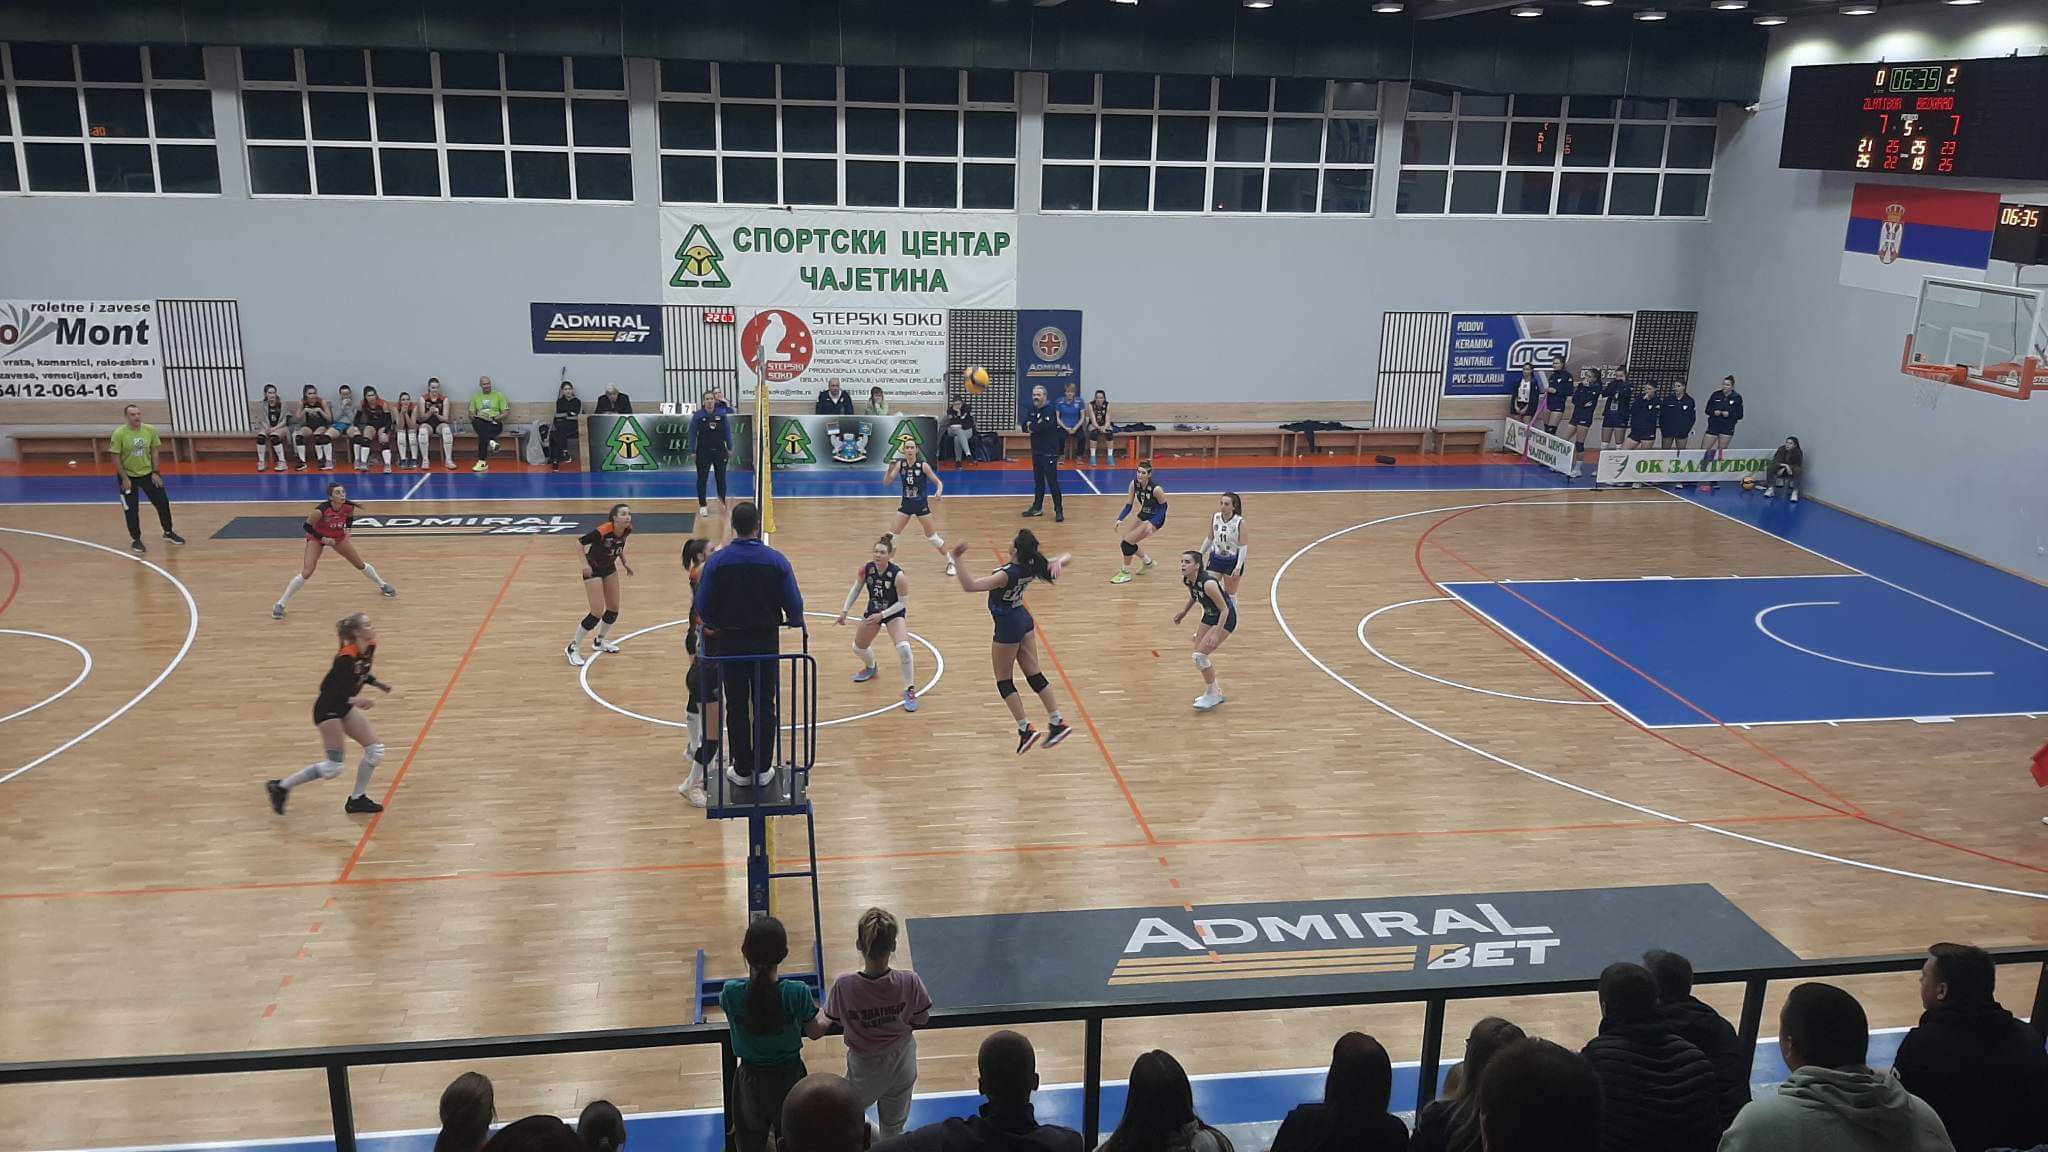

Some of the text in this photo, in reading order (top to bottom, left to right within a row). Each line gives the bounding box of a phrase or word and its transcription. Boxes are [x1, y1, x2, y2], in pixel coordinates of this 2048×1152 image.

[1875, 68, 1958, 90] 0 06:35 2
[1879, 114, 1961, 137] 7 5 7
[1858, 139, 1873, 152] 21
[1910, 139, 1927, 155] 25
[2000, 208, 2040, 228] 06:35
[732, 226, 1011, 259] СПОРТСКИ ЦЕНТАР
[799, 266, 949, 293] ЧАЈЕТИНА
[30, 302, 151, 314] roletne i zavese
[550, 313, 650, 330] ADMIRAL
[812, 311, 942, 327] STEPSKI SOKO
[1457, 321, 1484, 332] PODOVI
[54, 317, 150, 346] Mont
[614, 331, 650, 342] BET
[1455, 338, 1493, 349] KERAMIKA
[767, 362, 804, 371] STEPSKI
[767, 371, 793, 380] SOKO
[1452, 374, 1466, 384] PVC
[351, 515, 580, 527] ADMIRAL
[489, 525, 577, 534] BET
[1122, 903, 1554, 954] ADMIRAL
[1426, 938, 1561, 970] BET
